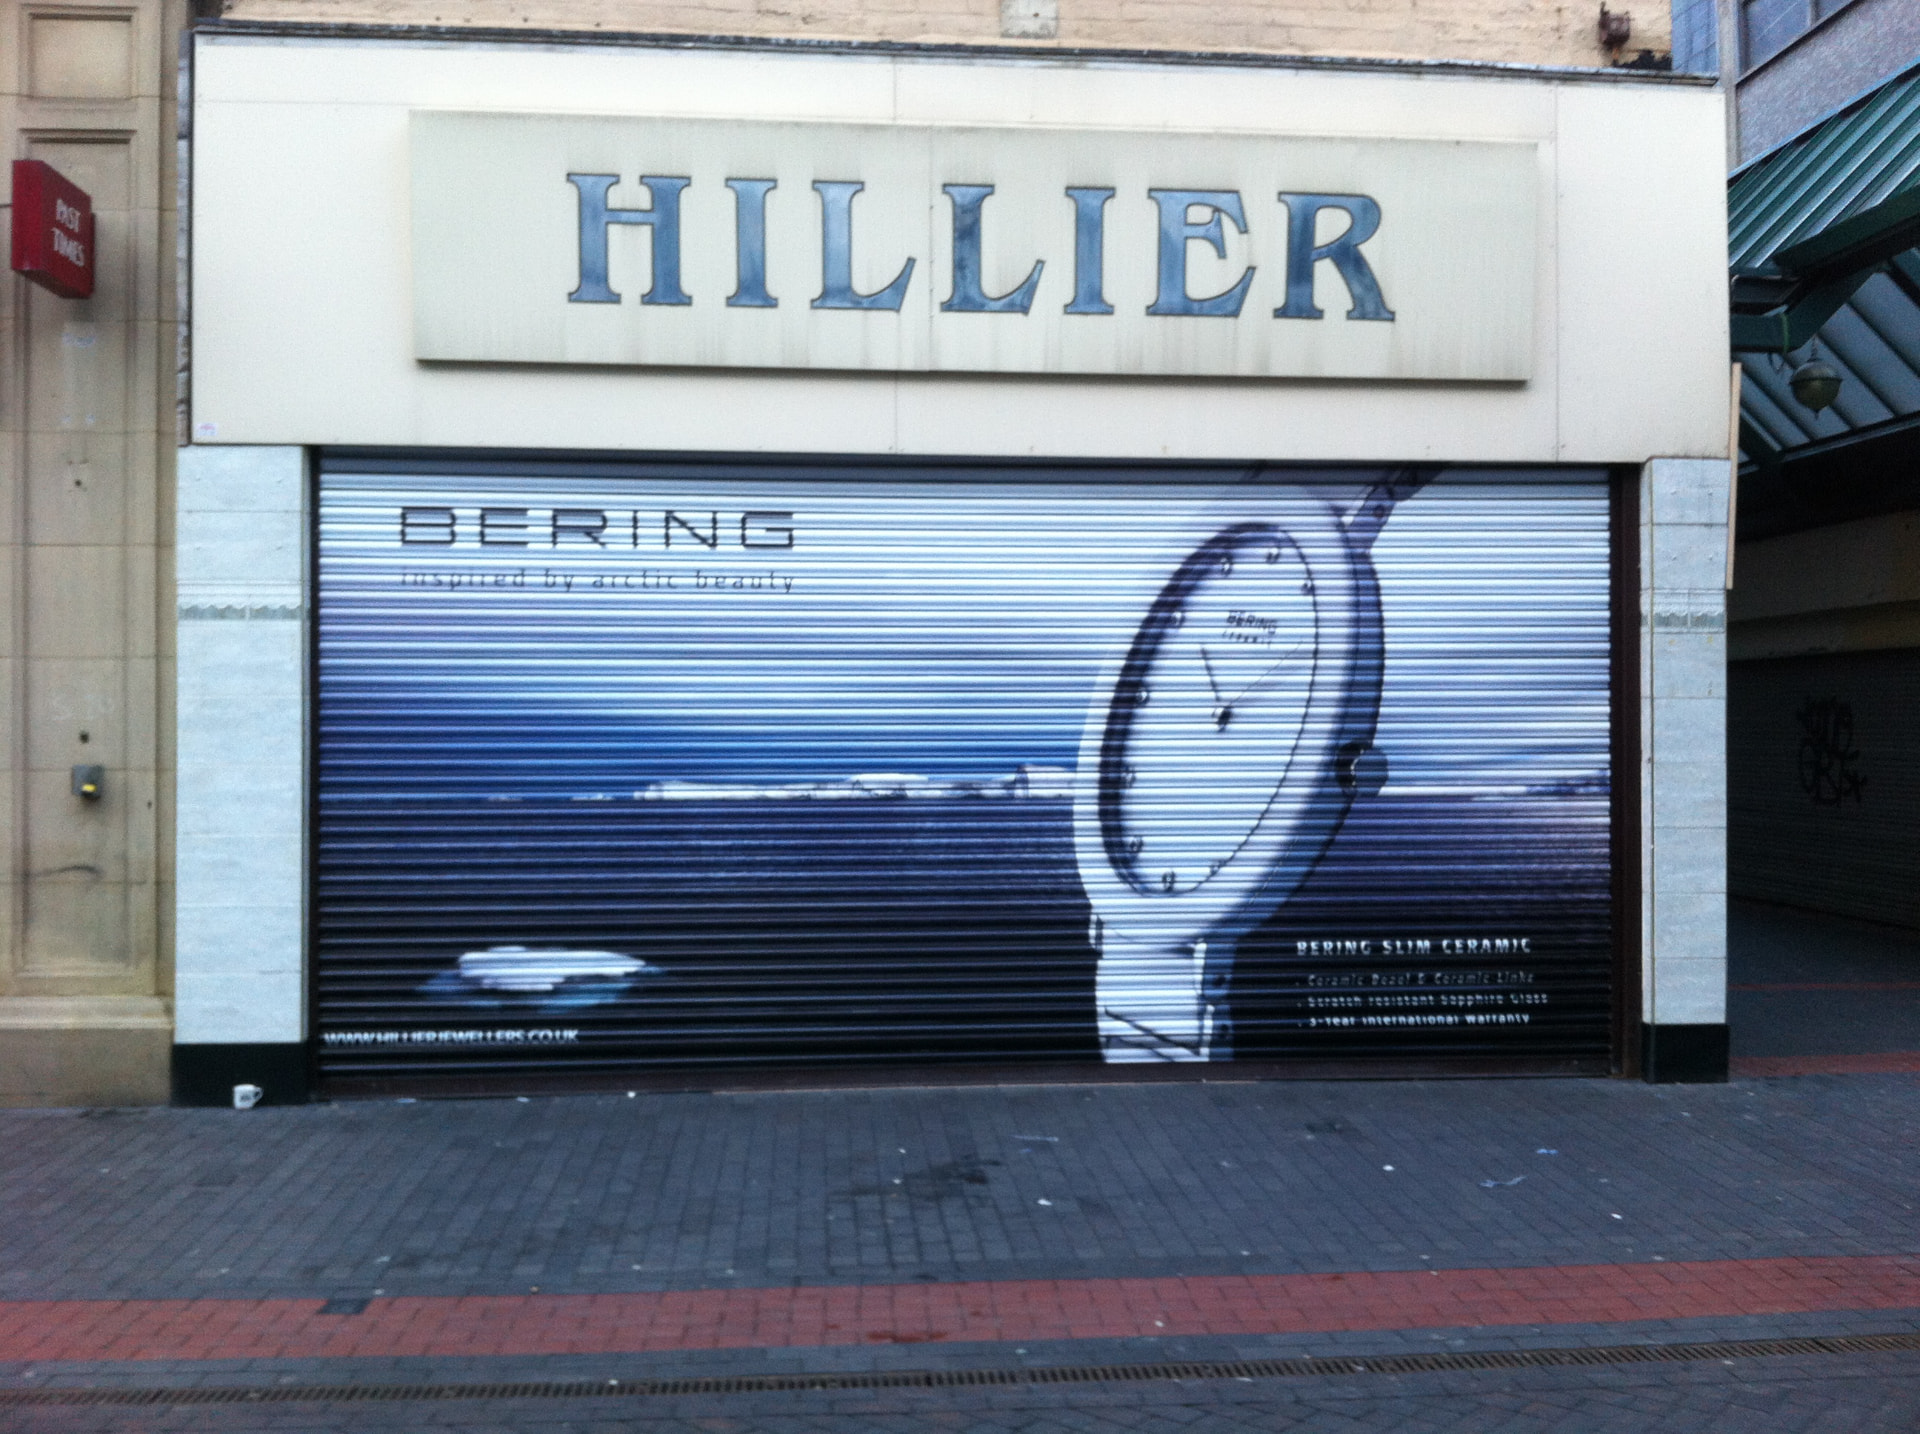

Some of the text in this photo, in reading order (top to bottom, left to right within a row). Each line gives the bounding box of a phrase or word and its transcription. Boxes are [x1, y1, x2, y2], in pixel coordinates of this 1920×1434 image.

[566, 172, 1396, 322] HILLIER
[401, 506, 794, 551] BERING
[401, 567, 795, 594] inspired by arctic beauty
[1297, 938, 1532, 956] BERING SLIM CERAMIC
[1307, 974, 1364, 988] Ceramic
[1434, 971, 1491, 985] Ceramic
[323, 1029, 579, 1044] WWWHILLIERJEWELLERSCOUK
